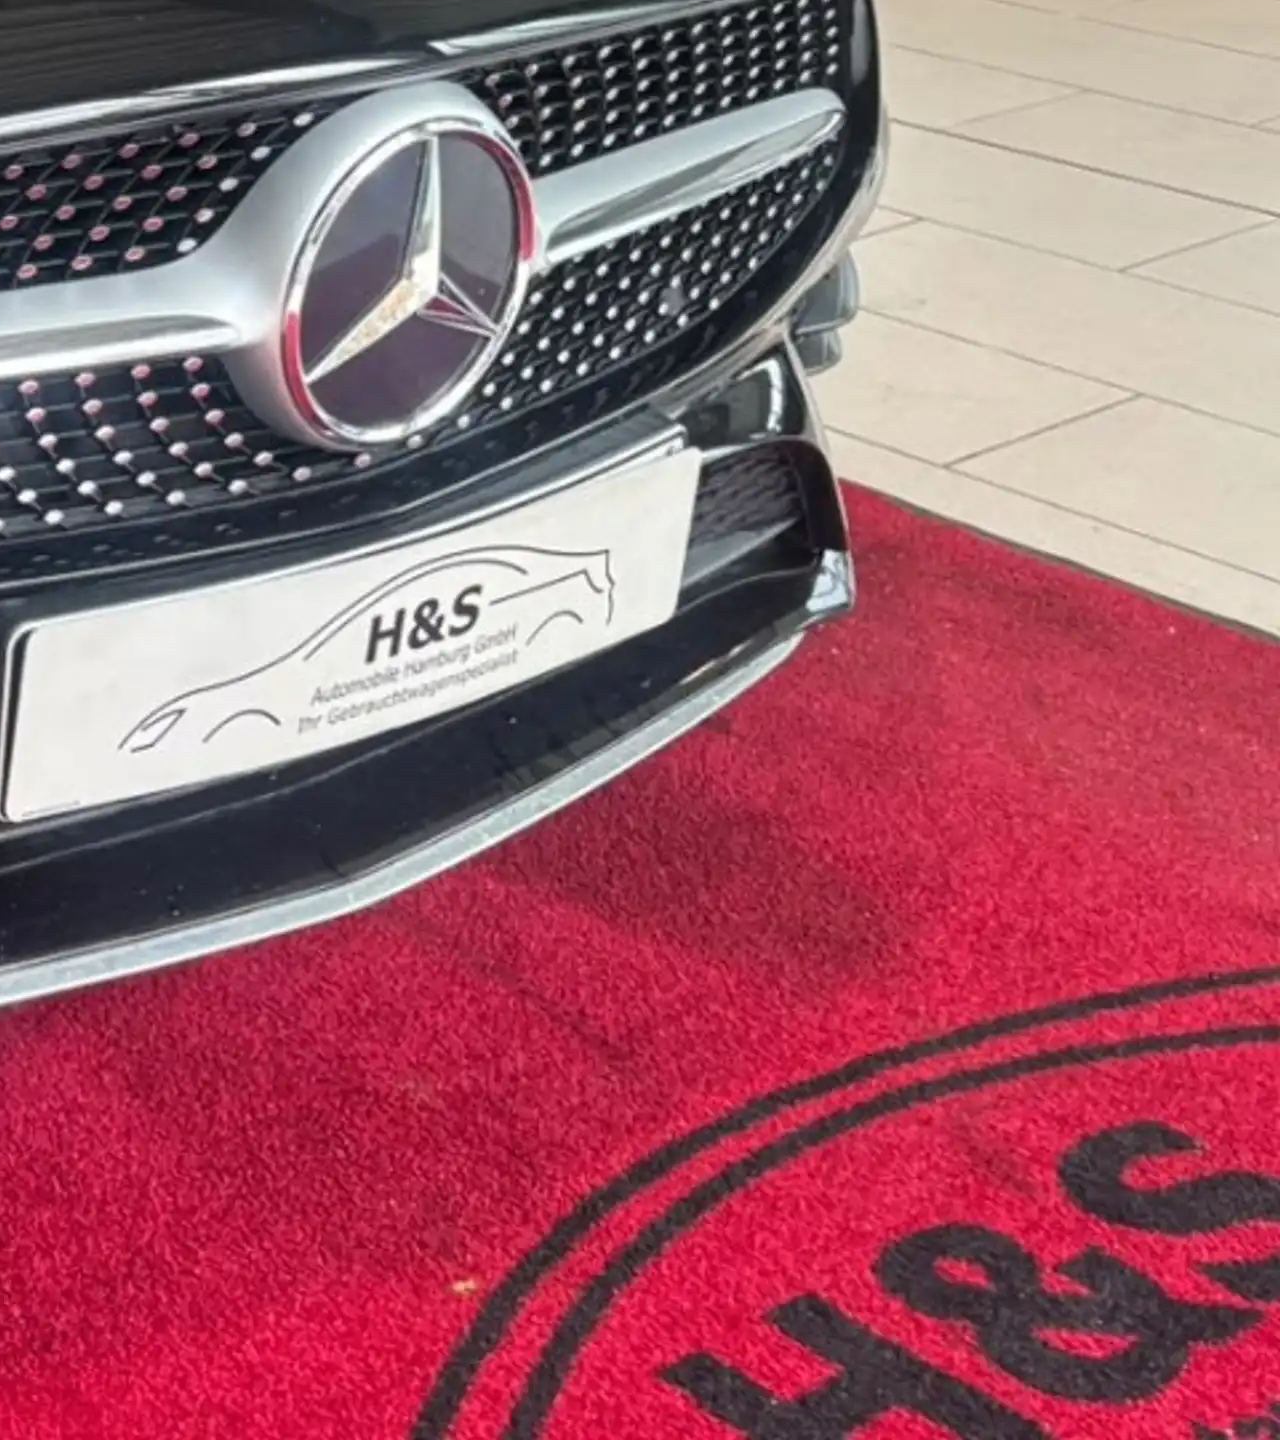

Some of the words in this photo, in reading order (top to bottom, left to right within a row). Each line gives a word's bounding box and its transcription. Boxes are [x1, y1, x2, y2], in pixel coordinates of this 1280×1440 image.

[311, 664, 401, 706] Automobile
[403, 642, 472, 679] Hamburg
[474, 622, 519, 654] GmbH
[365, 584, 483, 665] H&S
[662, 1120, 1280, 1440] H&S
